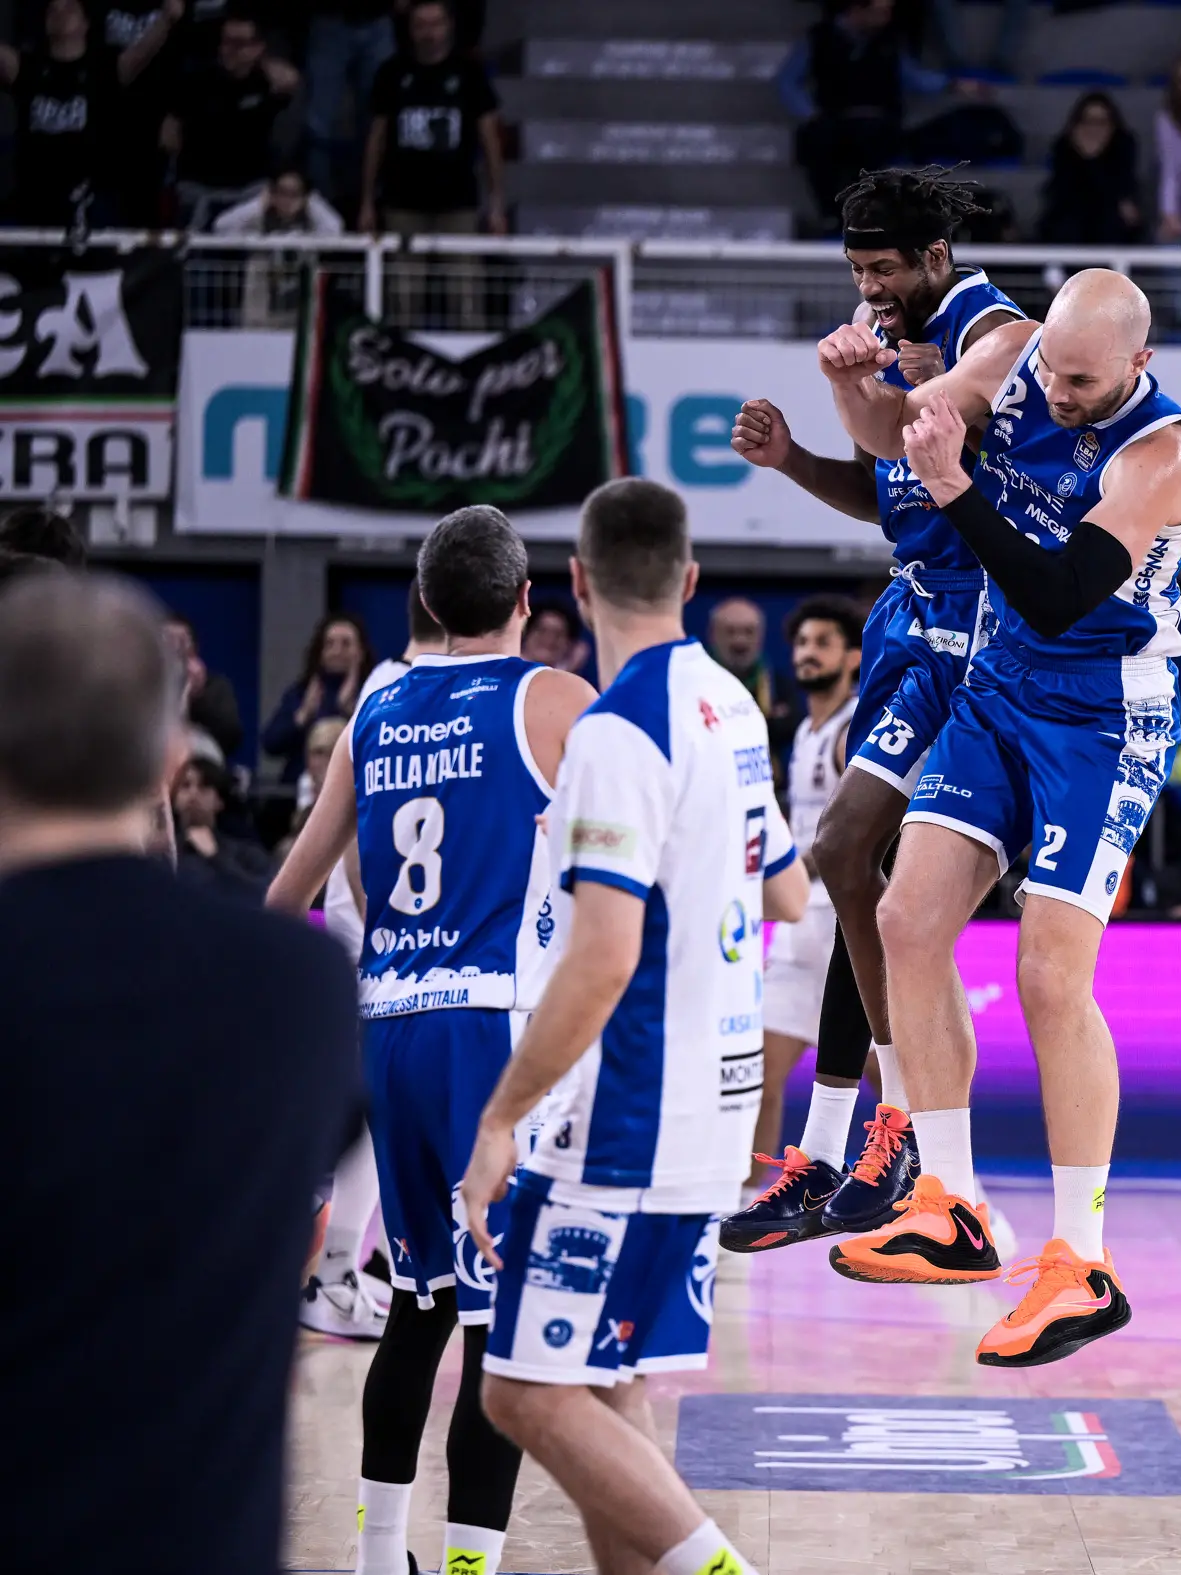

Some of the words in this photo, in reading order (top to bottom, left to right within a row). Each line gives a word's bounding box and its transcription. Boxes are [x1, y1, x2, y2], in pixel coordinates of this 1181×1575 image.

[1000, 381, 1027, 419] 2
[1079, 444, 1095, 460] LBA
[888, 487, 907, 498] LIFE
[866, 706, 915, 756] 23
[365, 755, 422, 796] DELLA
[425, 743, 484, 786] VALLE
[388, 797, 444, 914] 8
[1045, 823, 1077, 872] 2
[421, 988, 469, 1008] D'ITALIA
